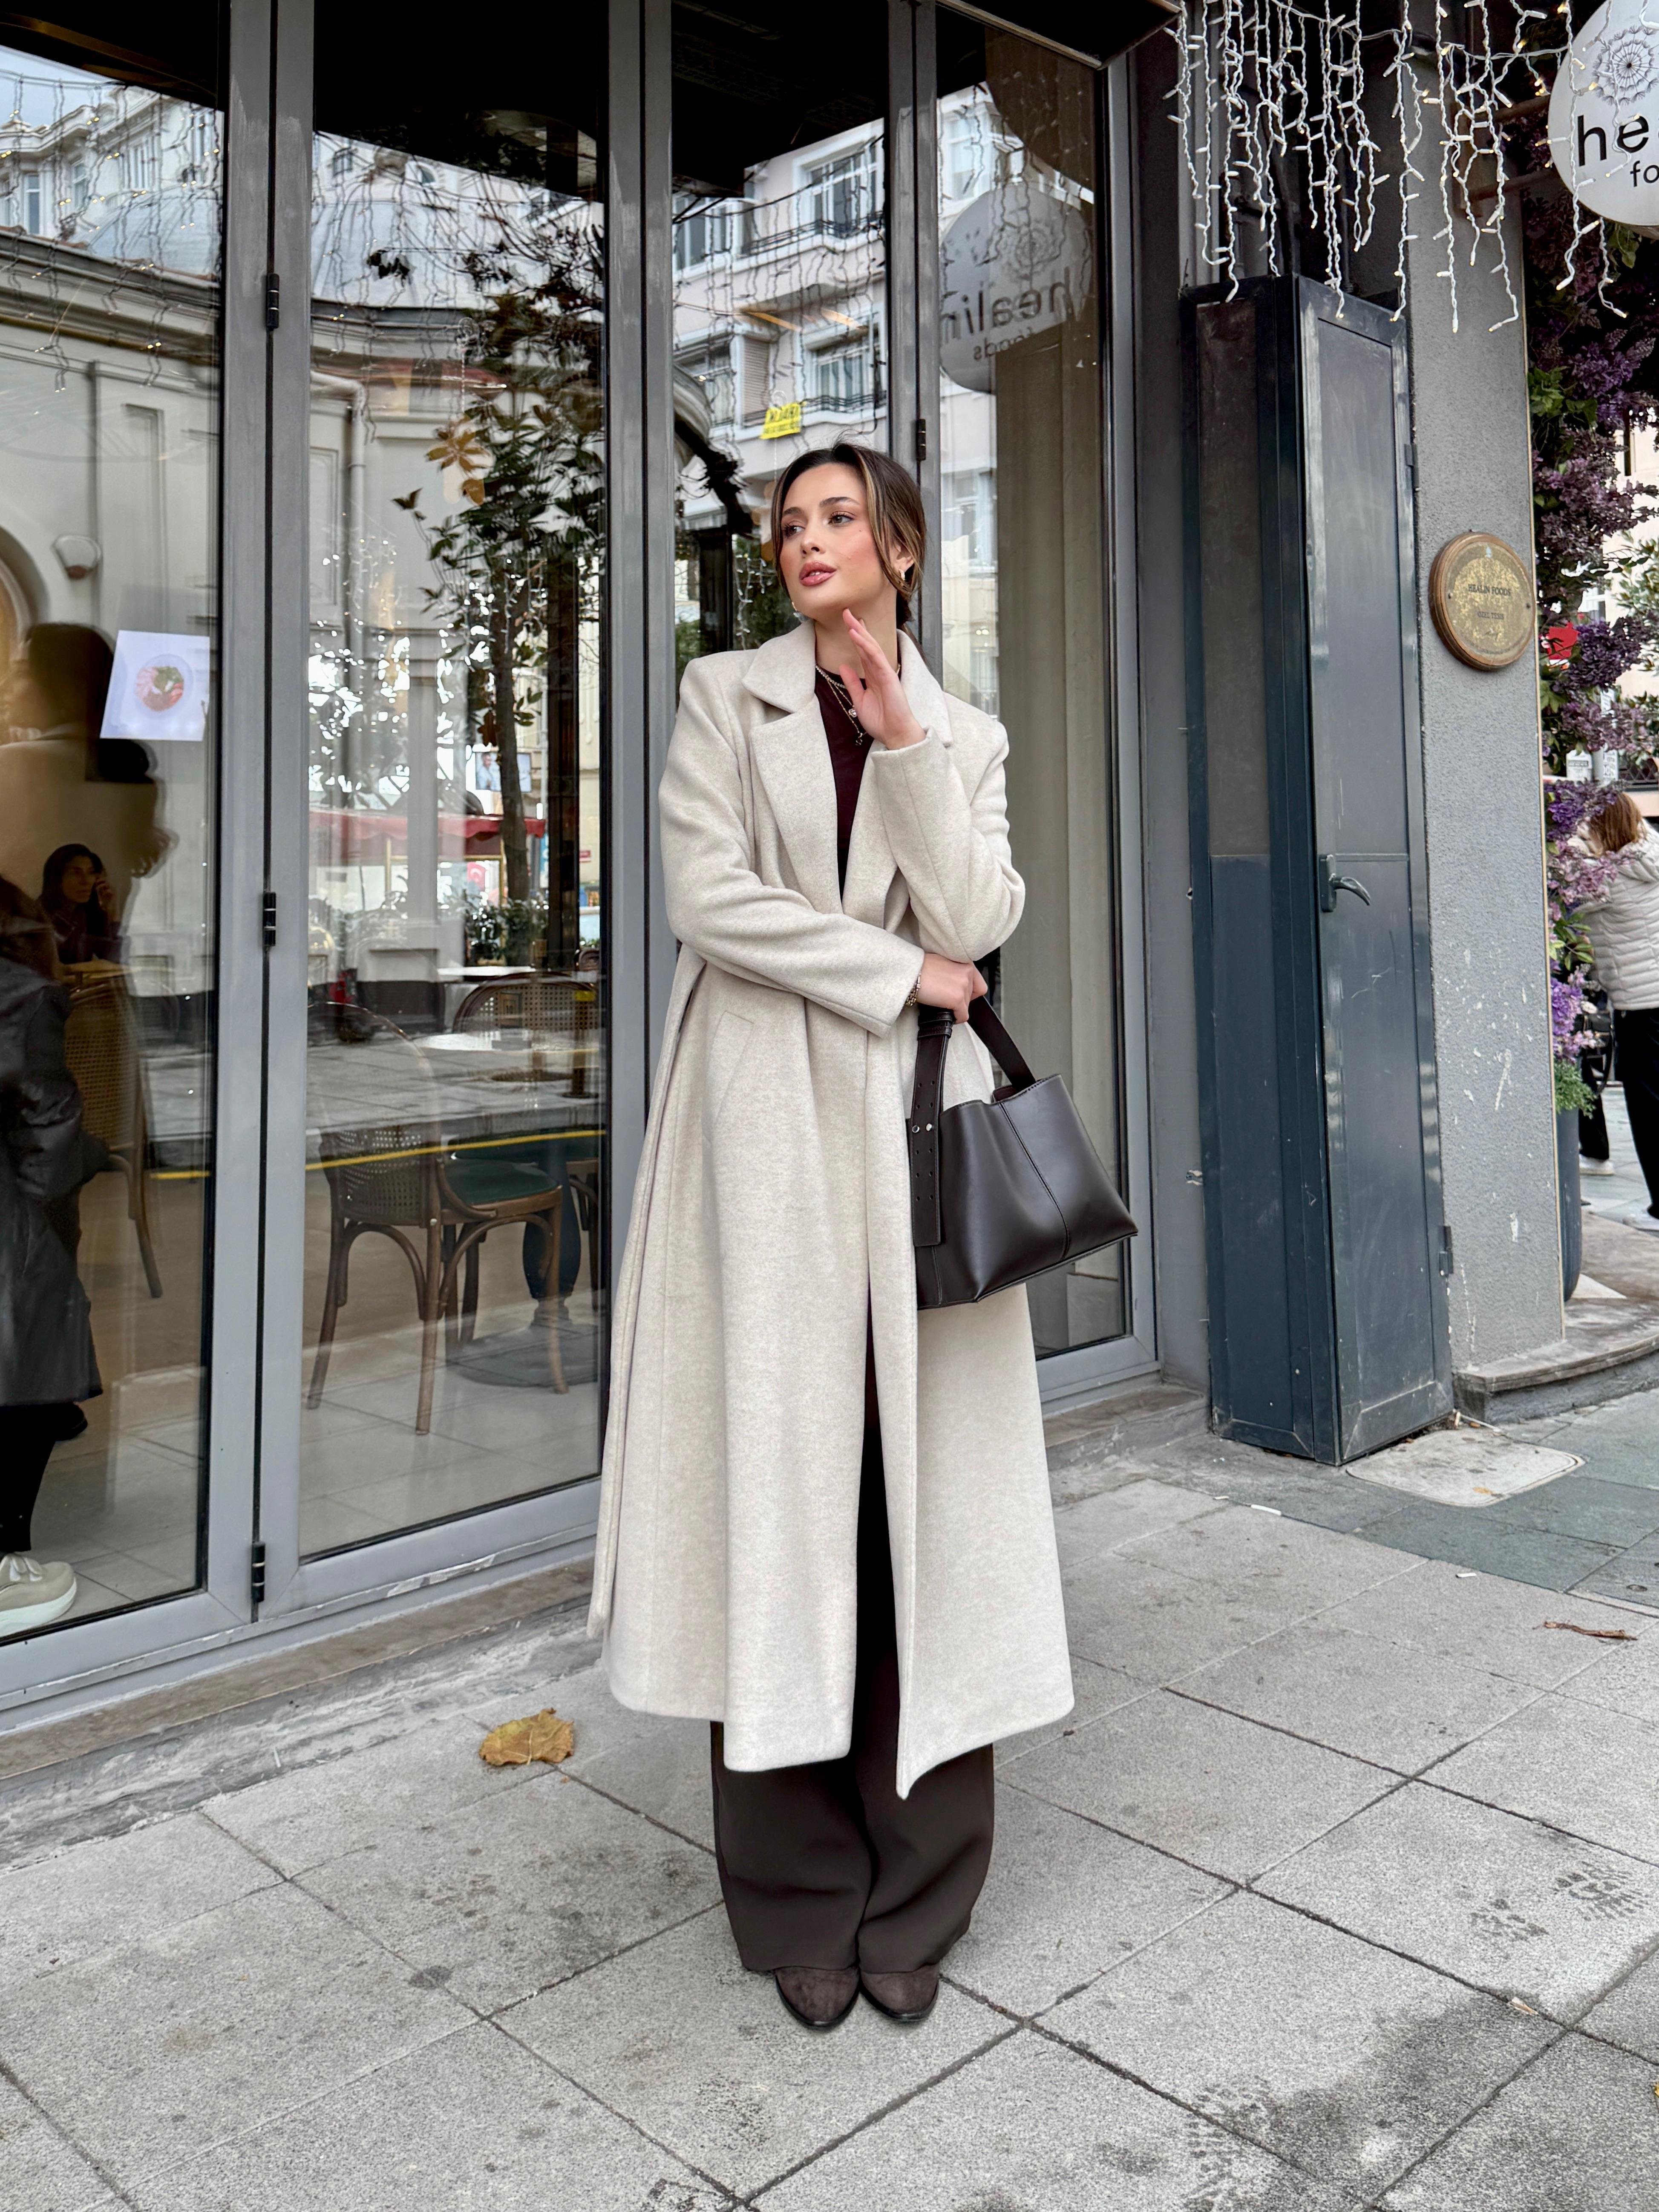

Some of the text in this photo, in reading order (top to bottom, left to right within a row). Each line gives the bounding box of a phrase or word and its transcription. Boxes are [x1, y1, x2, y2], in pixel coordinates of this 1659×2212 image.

[1578, 115, 1659, 167] he
[1468, 584, 1511, 596] HEALIN FOODS
